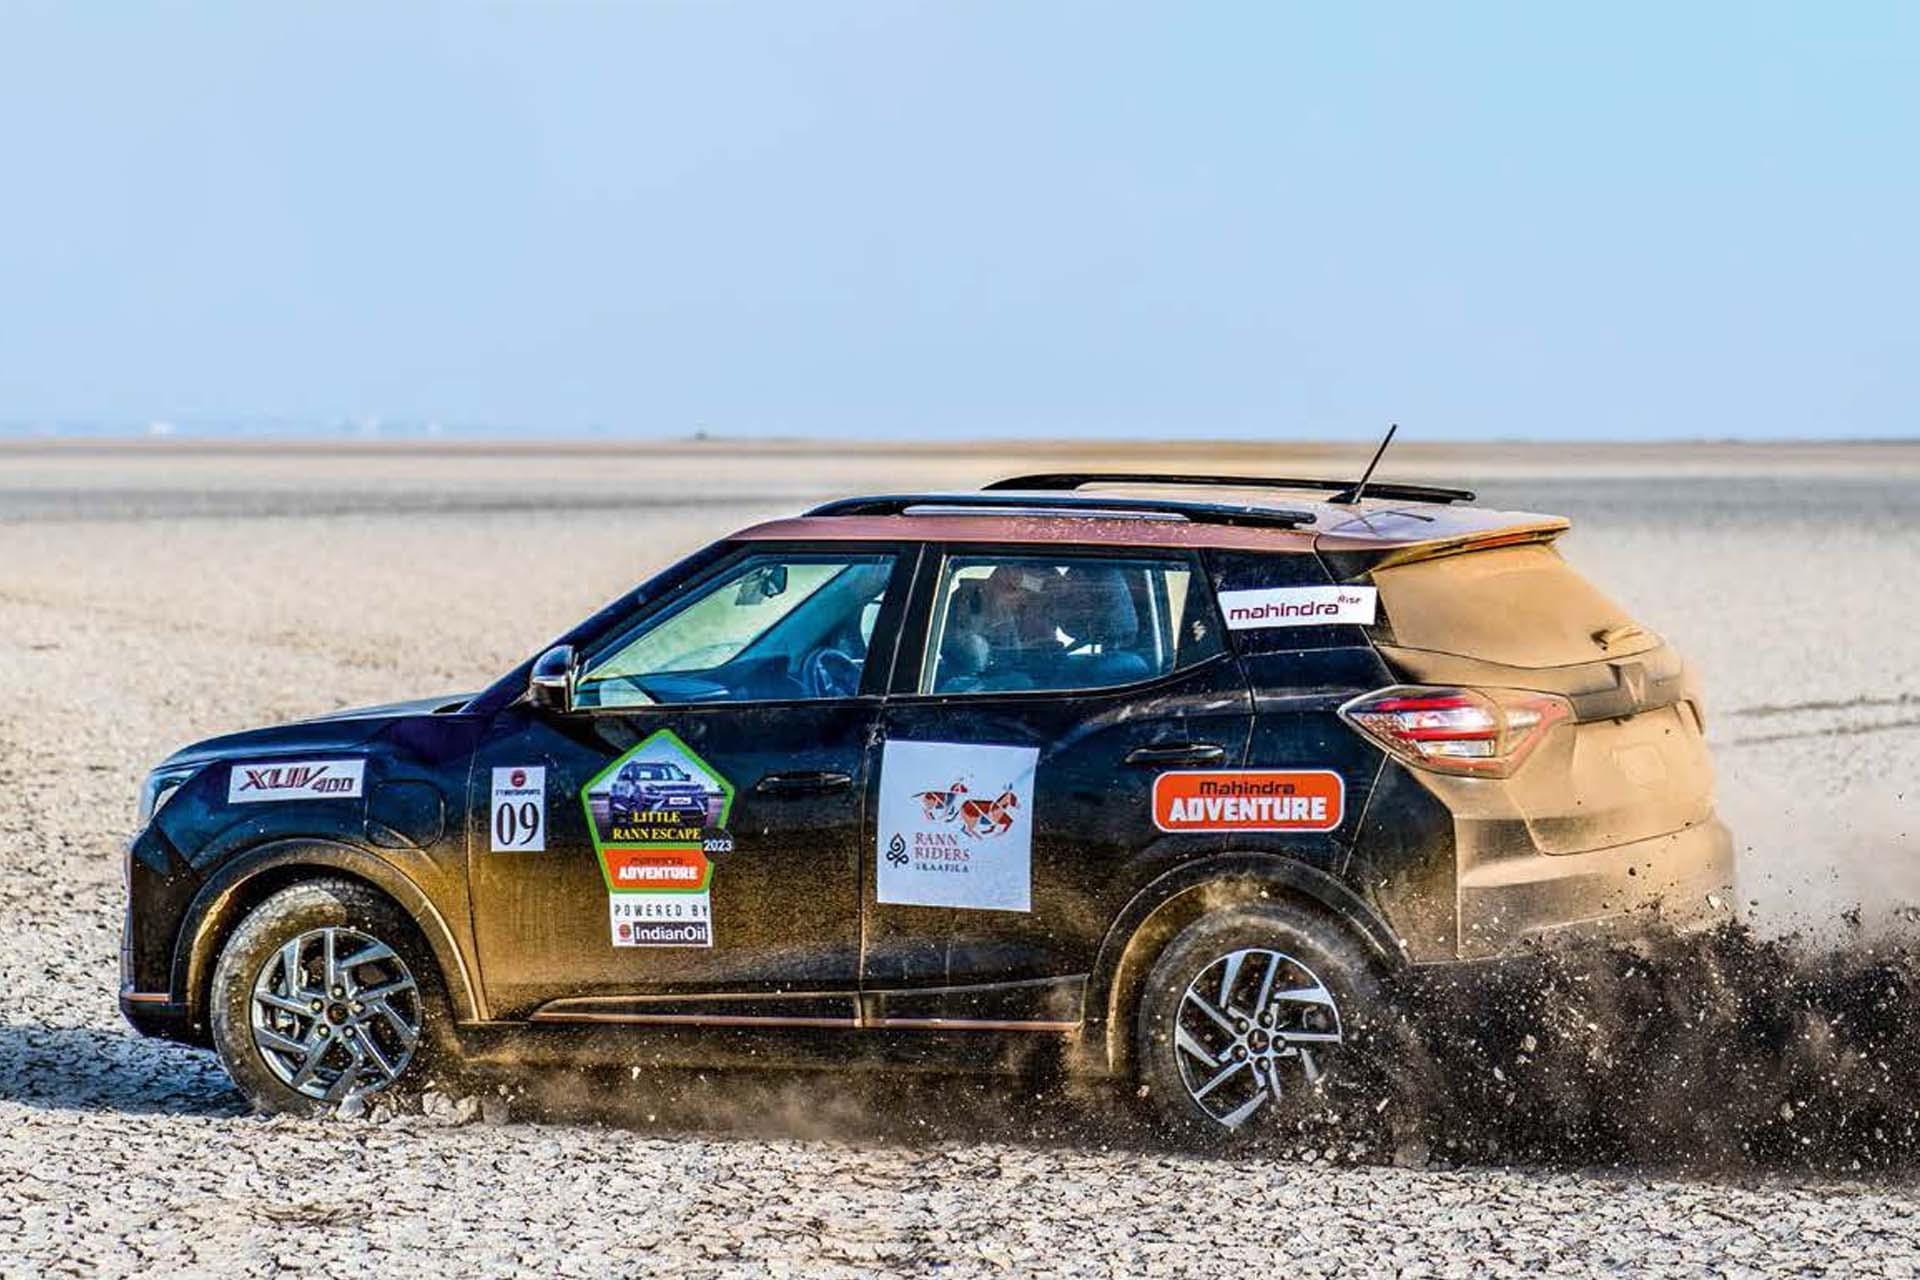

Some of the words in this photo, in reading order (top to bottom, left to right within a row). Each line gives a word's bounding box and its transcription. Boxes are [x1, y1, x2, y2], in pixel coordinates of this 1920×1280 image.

[1230, 601, 1339, 621] mahindra
[1168, 797, 1328, 822] ADVENTURE
[496, 802, 540, 846] 09
[633, 811, 680, 823] LITTLE
[613, 828, 649, 840] RANN
[652, 828, 700, 840] ESCAPE
[703, 839, 732, 852] 2023
[915, 847, 970, 861] RIDERS
[618, 866, 698, 880] ADVENTURE
[614, 904, 682, 917] POWERED
[692, 904, 708, 917] BY
[636, 926, 706, 940] IndianOil
